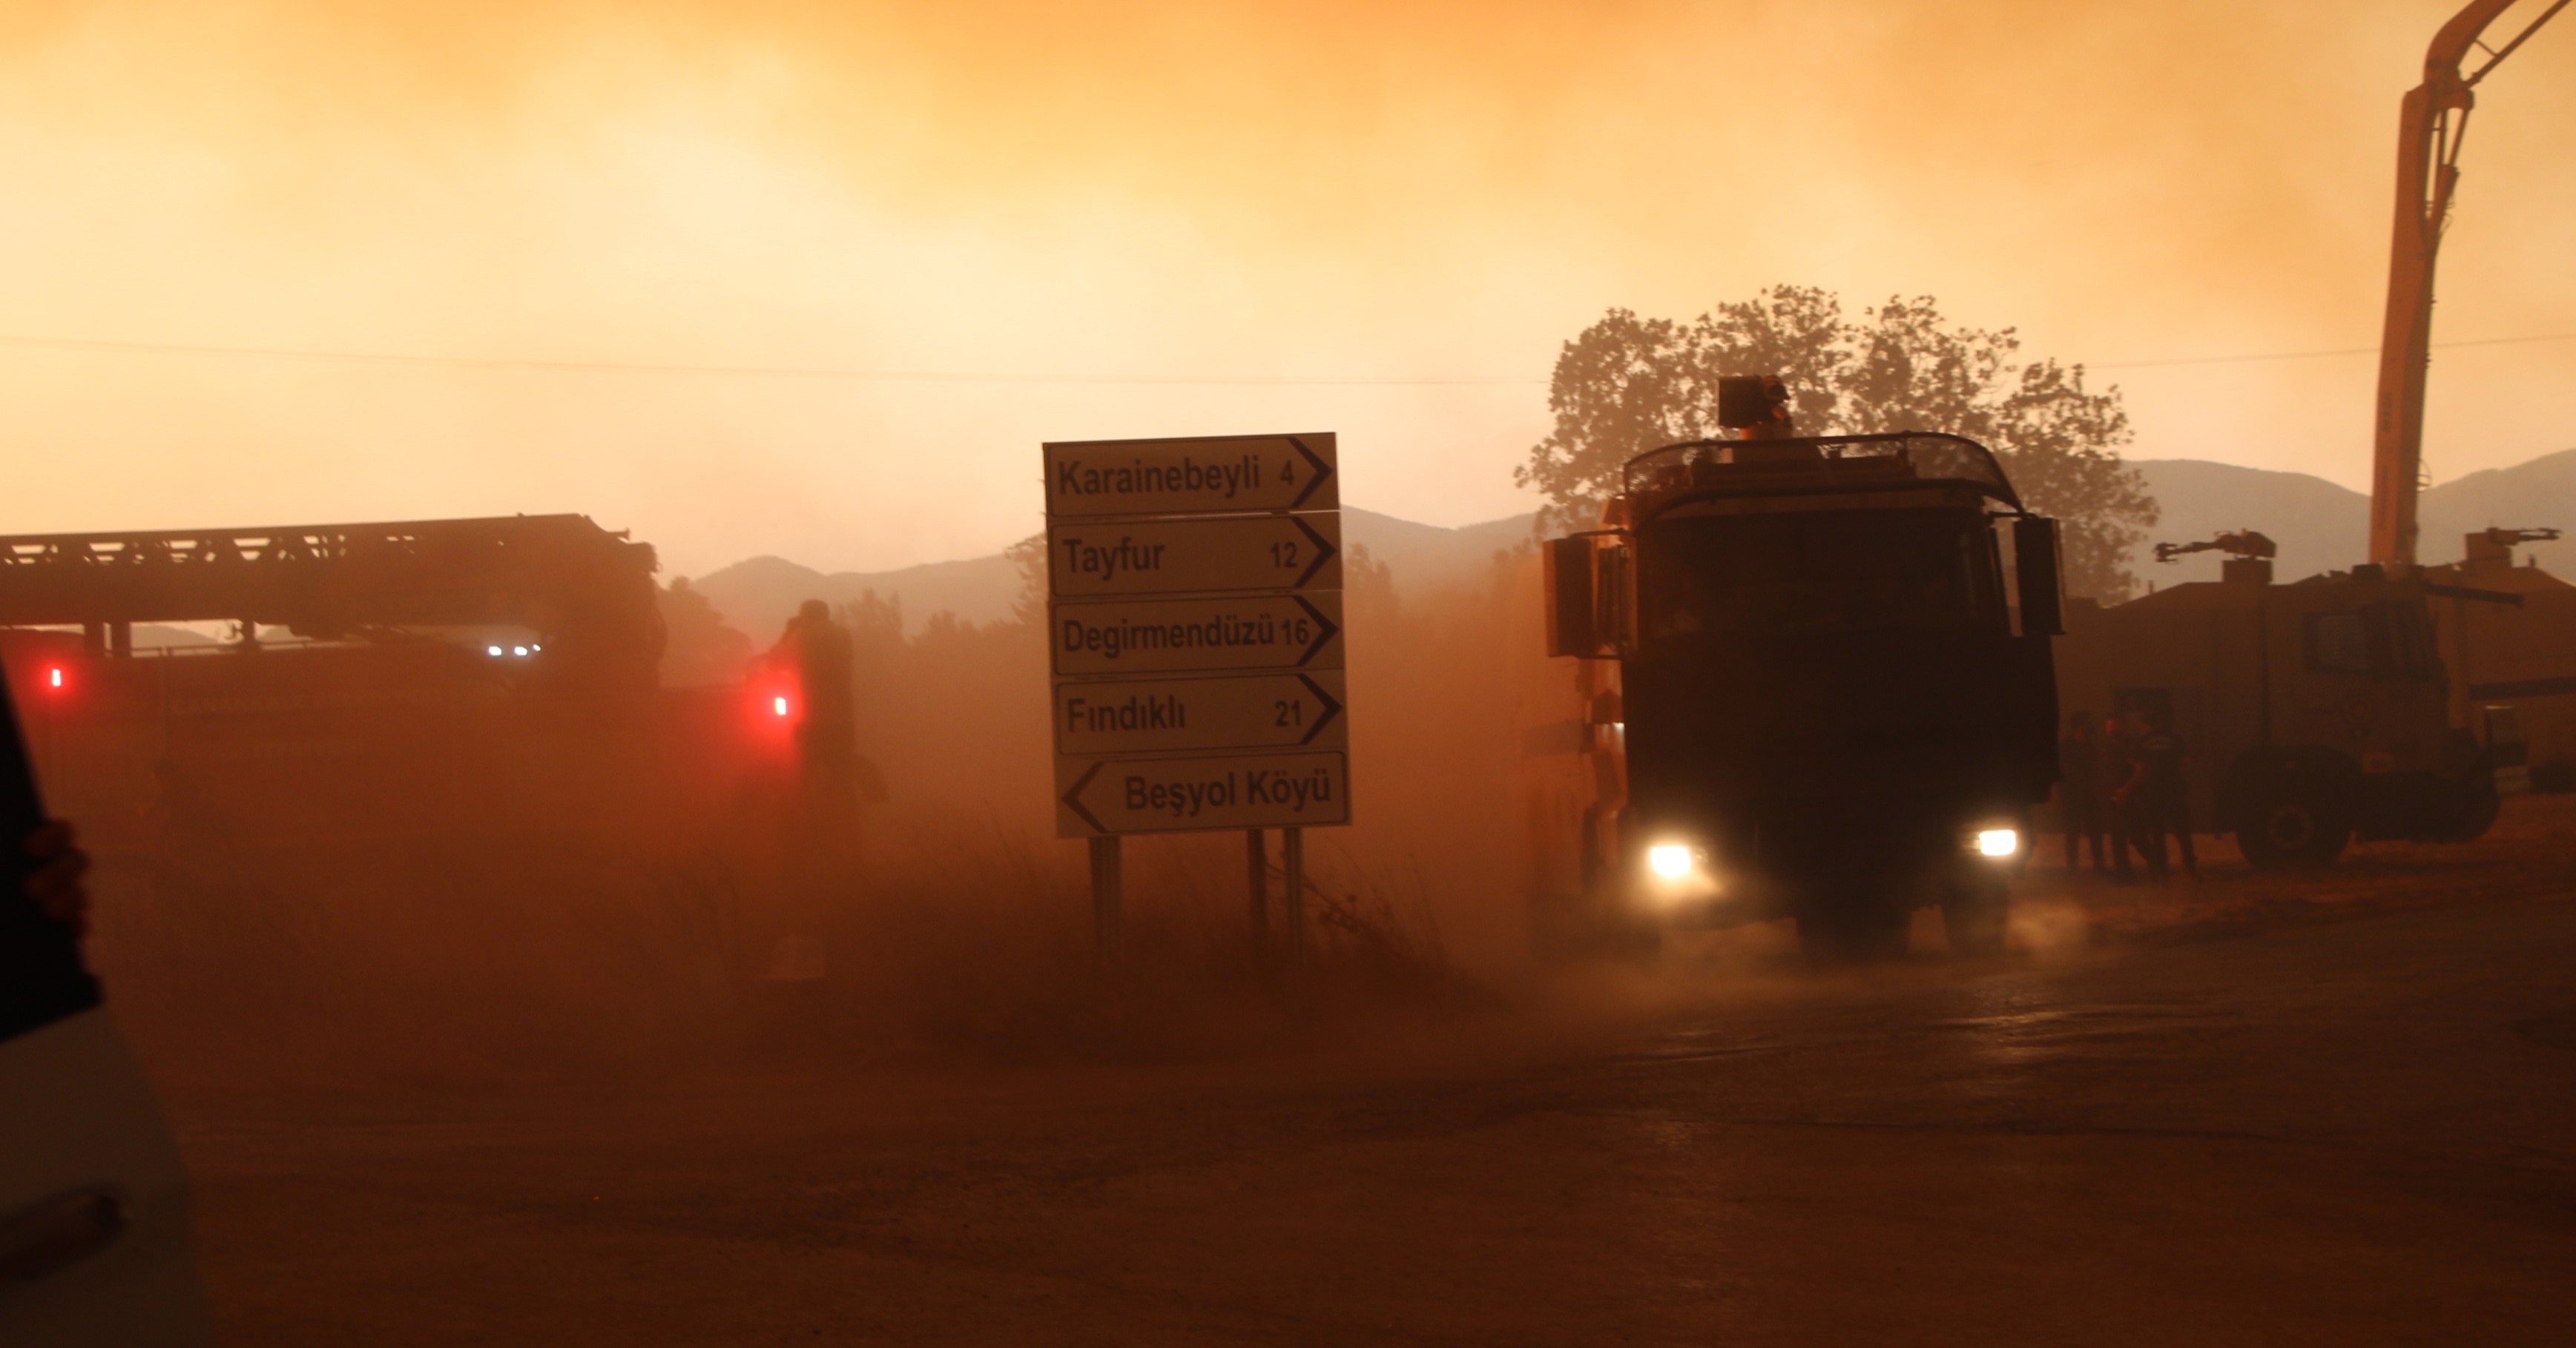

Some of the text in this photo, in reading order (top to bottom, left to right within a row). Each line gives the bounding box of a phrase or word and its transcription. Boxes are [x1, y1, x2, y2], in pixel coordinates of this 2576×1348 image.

[1058, 455, 1294, 498] Karainebeyli 4
[1063, 536, 1297, 581] Tayfur 12
[1064, 614, 1309, 658] Degirmendüzü 16
[1067, 695, 1302, 732] Fındıklı 21
[1125, 768, 1330, 817] Beşyol Köyü
